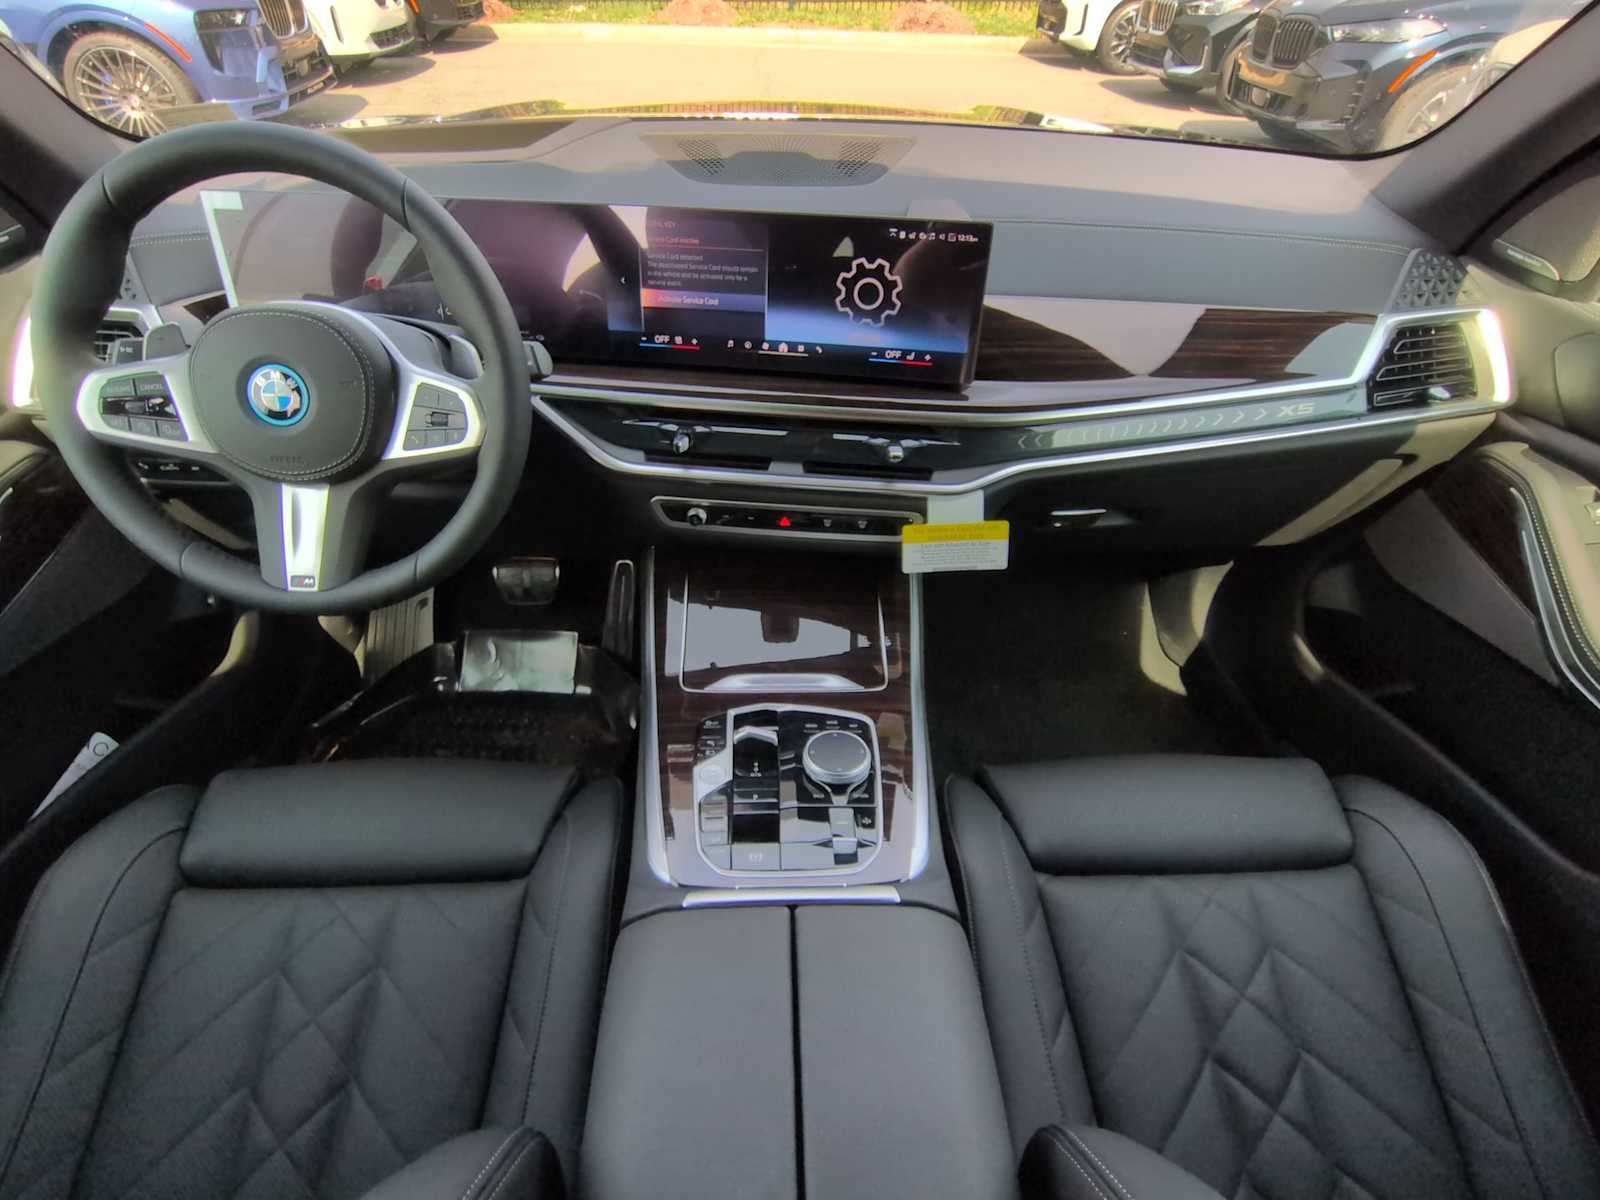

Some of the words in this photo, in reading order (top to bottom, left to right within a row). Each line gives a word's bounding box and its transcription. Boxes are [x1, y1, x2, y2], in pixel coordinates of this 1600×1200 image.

[682, 296, 704, 304] Service
[704, 297, 719, 305] Card
[654, 334, 670, 343] OFF
[884, 350, 902, 359] OFF
[255, 370, 298, 389] BMW
[1277, 402, 1315, 417] X5
